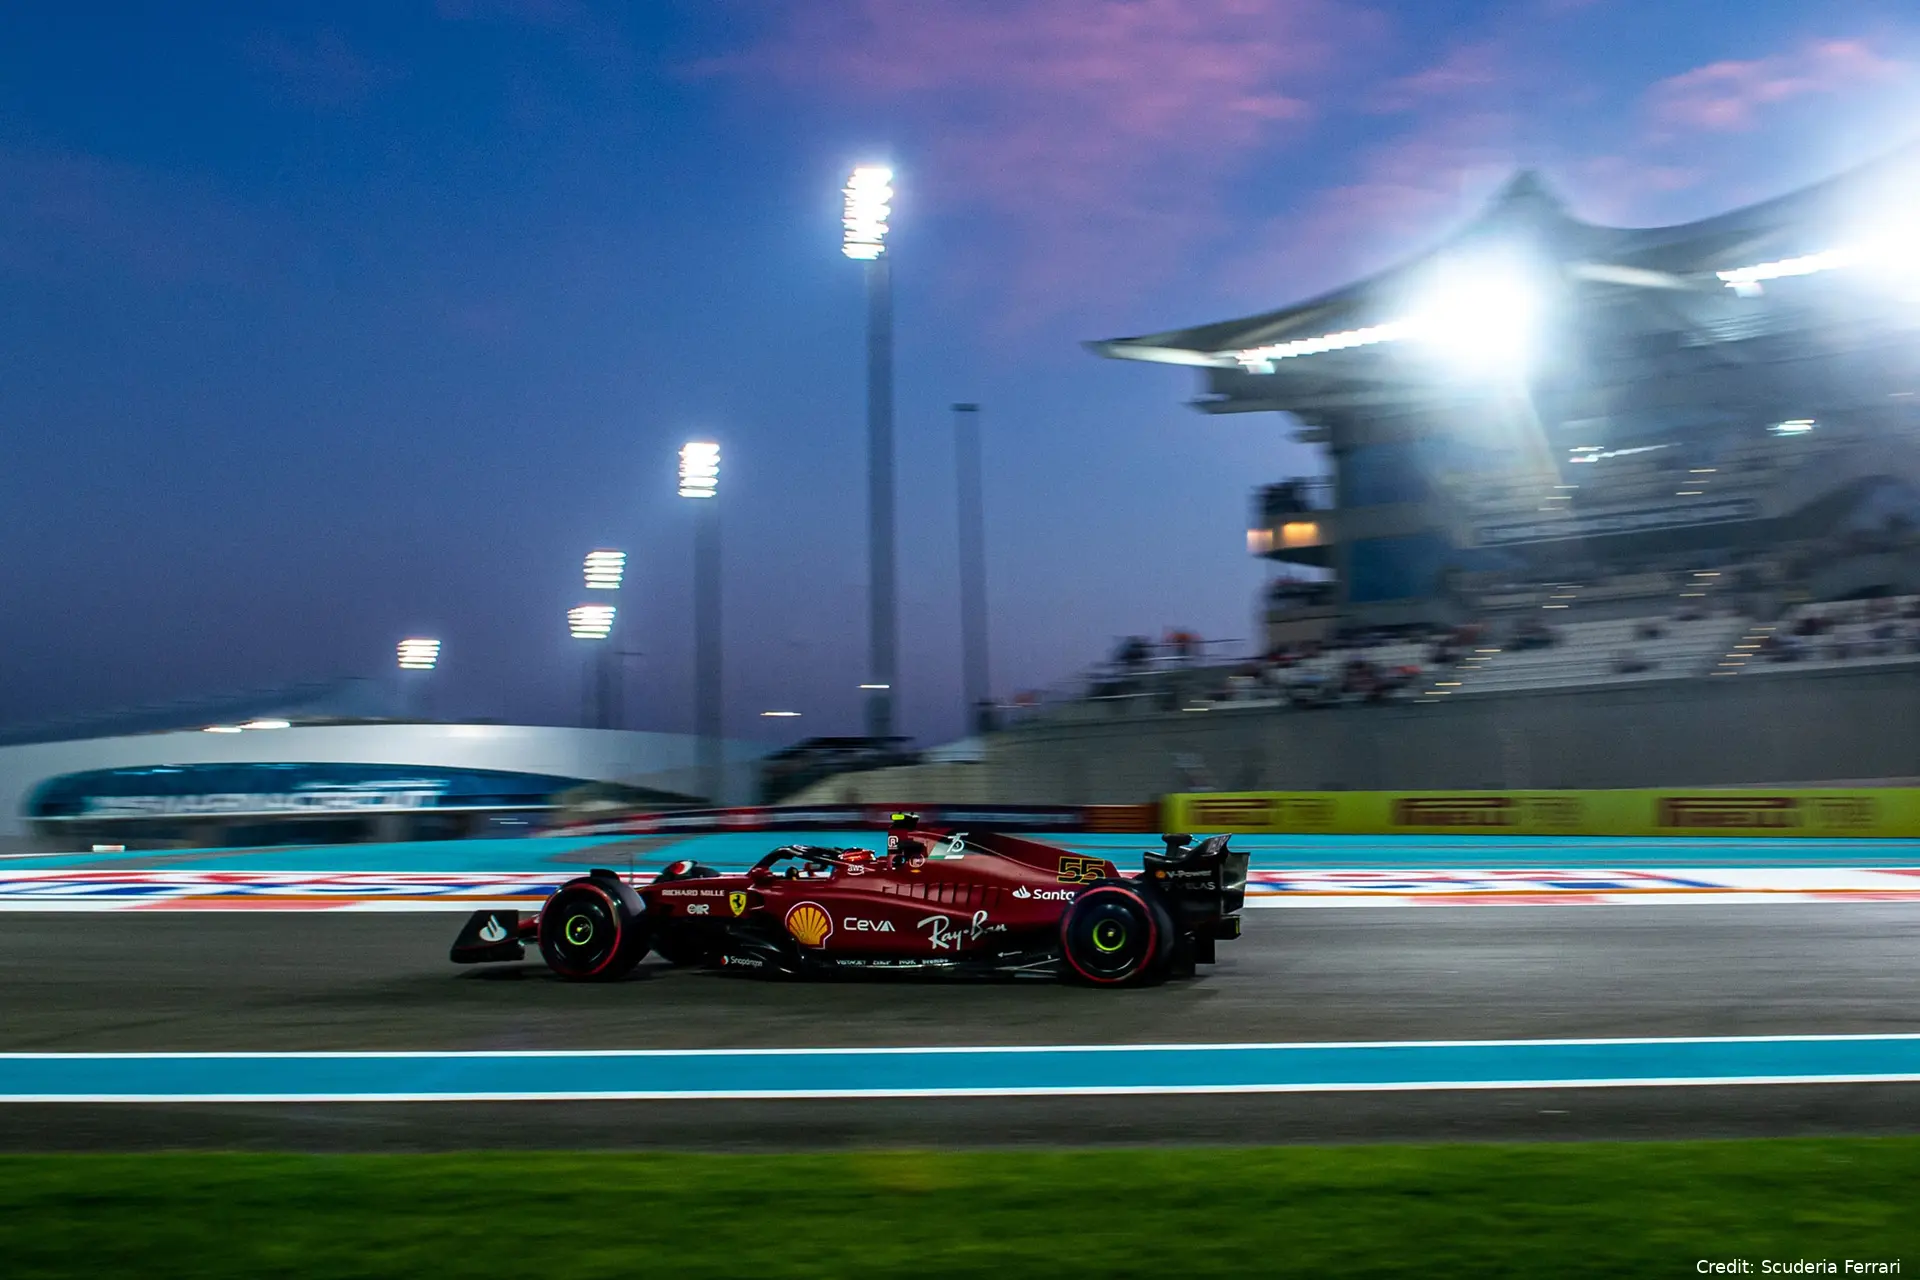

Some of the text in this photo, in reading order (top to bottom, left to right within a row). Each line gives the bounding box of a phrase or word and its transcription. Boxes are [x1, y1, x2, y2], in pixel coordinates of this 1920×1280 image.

[1057, 856, 1105, 885] 55
[661, 889, 725, 897] RICHARD MILLE
[916, 910, 1008, 950] Ray-Ban
